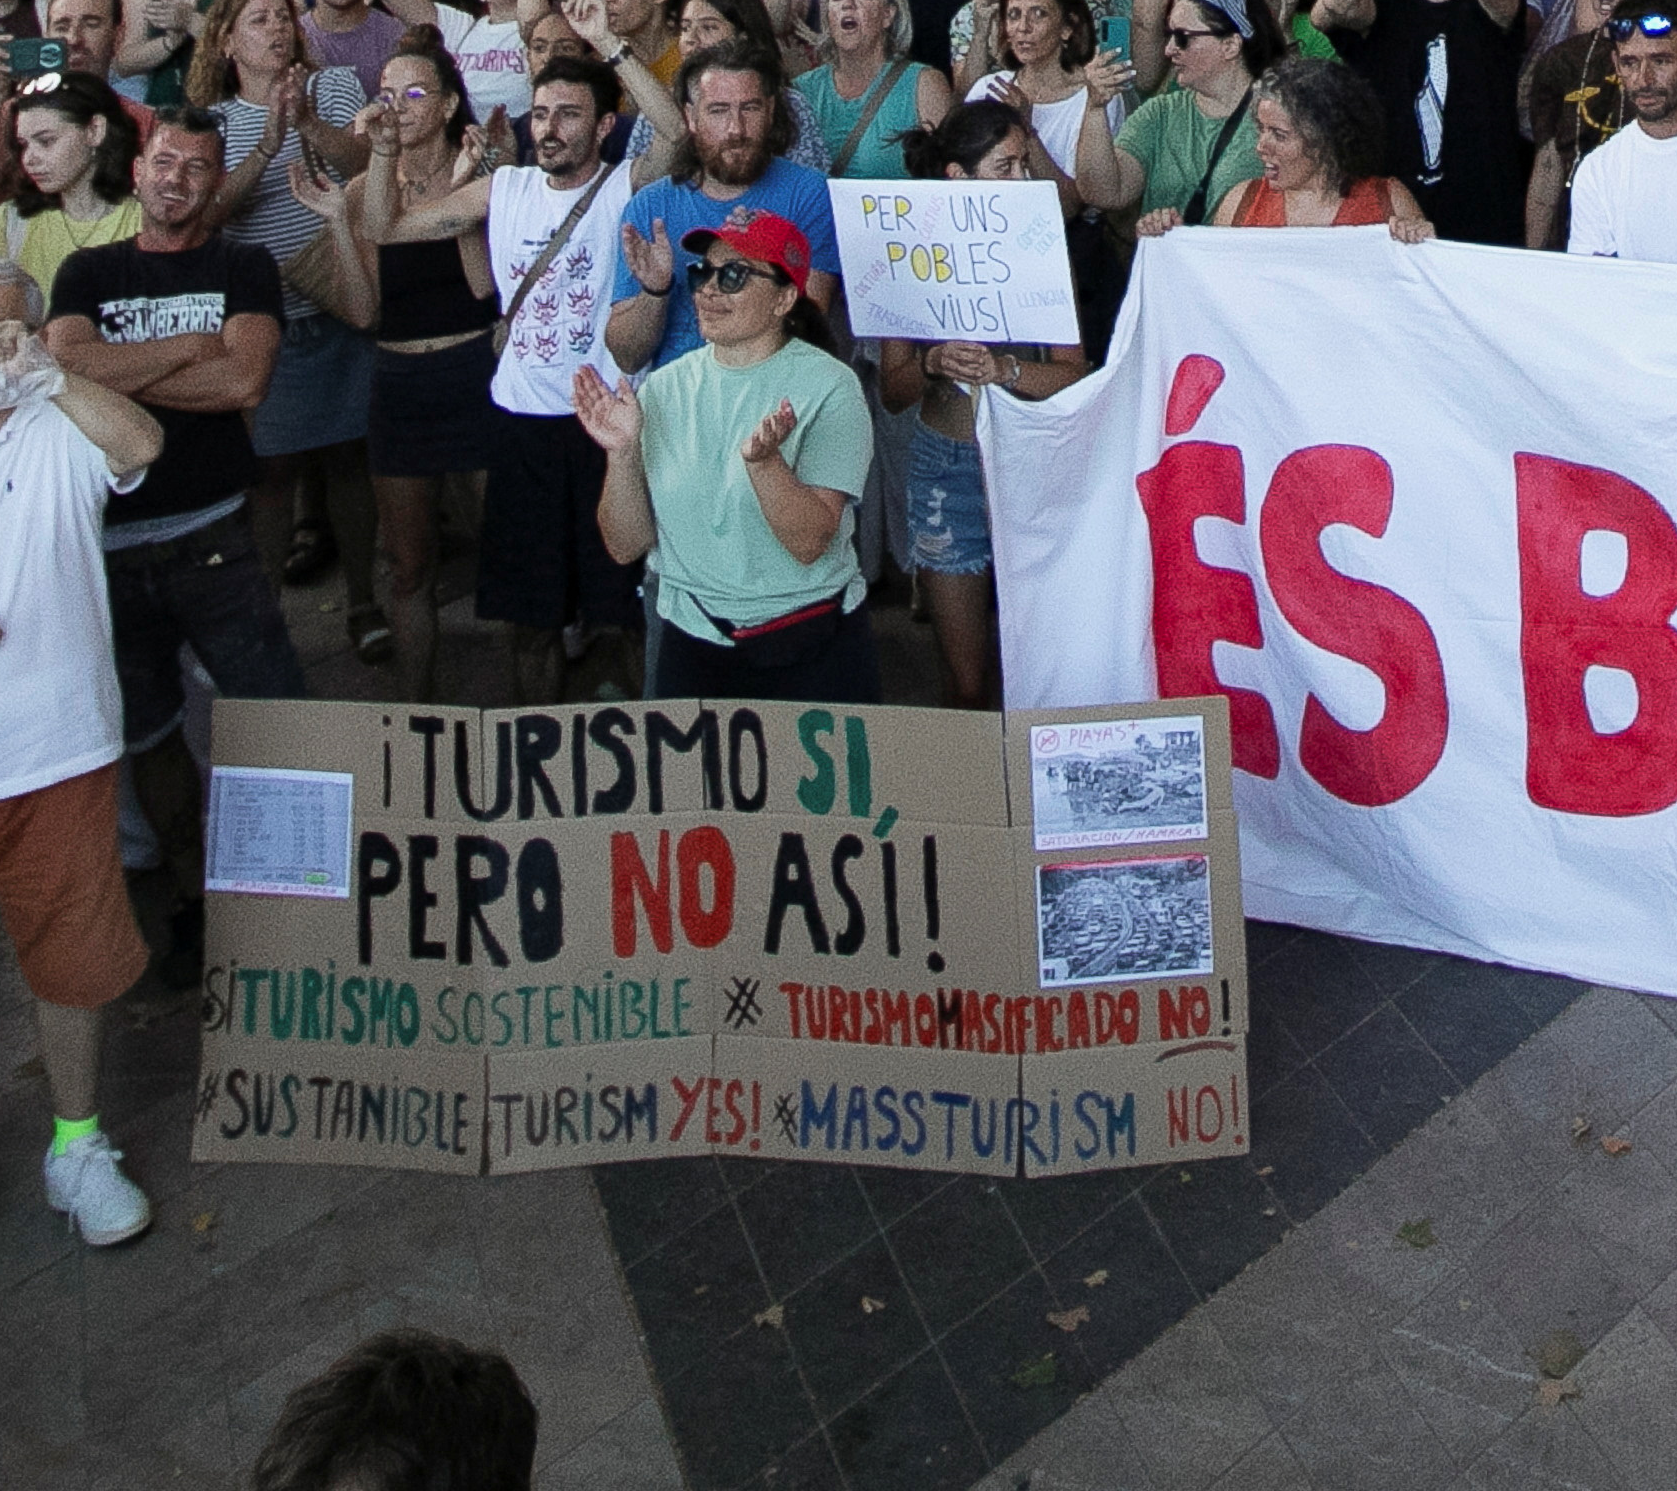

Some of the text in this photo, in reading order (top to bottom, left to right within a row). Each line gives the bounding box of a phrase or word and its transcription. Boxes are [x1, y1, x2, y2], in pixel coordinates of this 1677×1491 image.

[861, 194, 1009, 233] PER UNS
[886, 240, 1012, 286] POBLES
[1138, 350, 1447, 810] ÉS
[383, 706, 770, 823] ¡TURISMO
[359, 831, 564, 969] PERO
[610, 825, 738, 959] NO
[669, 1075, 762, 1155] YES!
[1166, 1073, 1245, 1148] NO!
